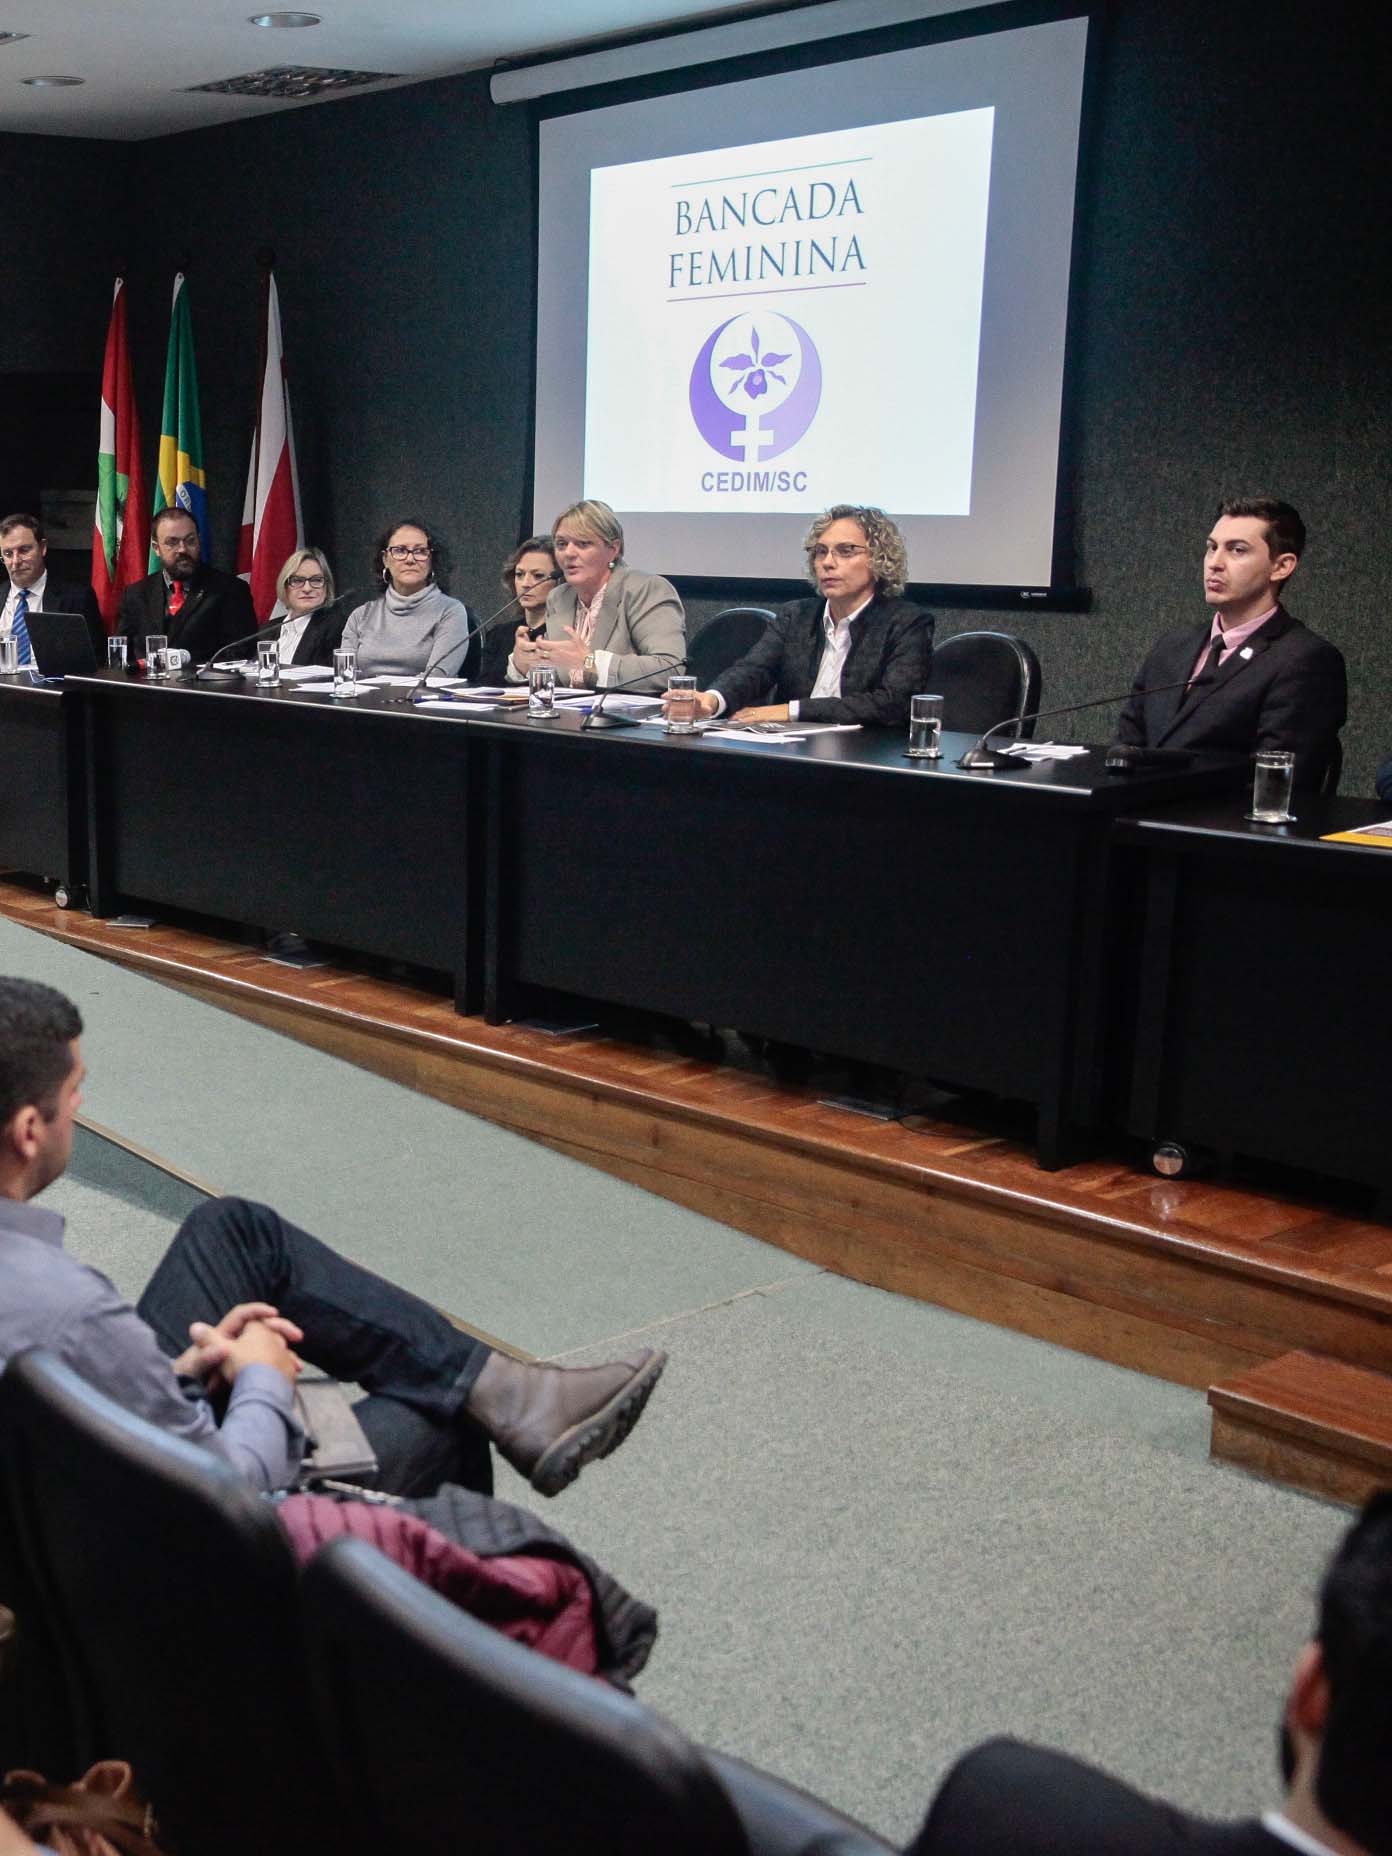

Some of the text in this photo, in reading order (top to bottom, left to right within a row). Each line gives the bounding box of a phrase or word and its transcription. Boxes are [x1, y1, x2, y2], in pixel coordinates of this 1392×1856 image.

[675, 178, 864, 236] BANCADA
[668, 234, 867, 288] FEMININA
[701, 471, 807, 492] CEDIM/SC
